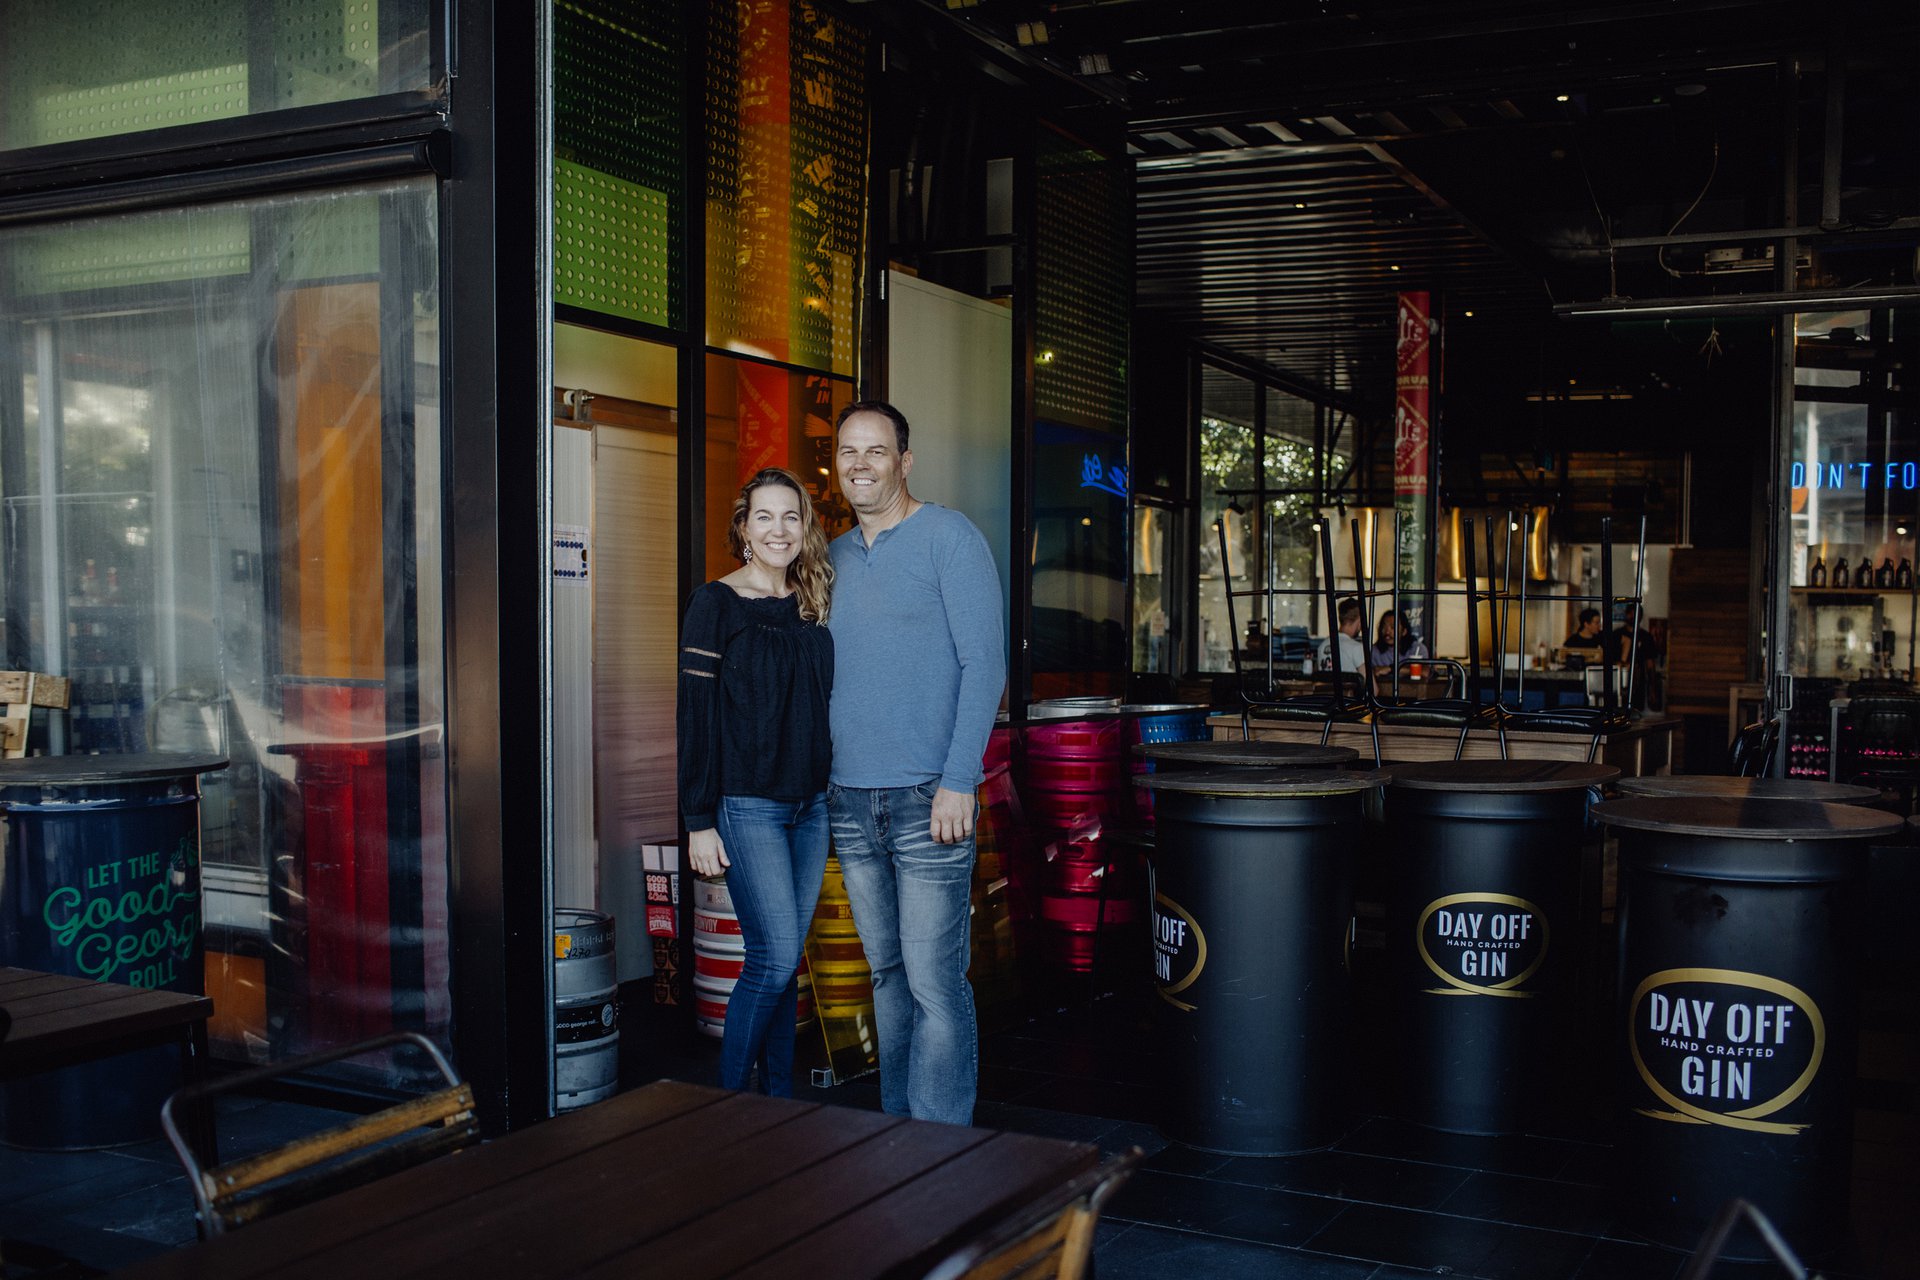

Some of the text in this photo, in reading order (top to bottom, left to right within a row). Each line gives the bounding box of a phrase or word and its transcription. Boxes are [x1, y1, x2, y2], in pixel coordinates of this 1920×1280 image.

[88, 852, 160, 889] LET THE
[646, 874, 668, 884] GOOD
[646, 882, 669, 894] BEER
[43, 867, 190, 946] Good
[1161, 916, 1187, 947] OFF
[1438, 911, 1532, 940] DAY OFF
[76, 912, 199, 983] Georg
[1446, 939, 1520, 949] HAND CRAFTED
[130, 958, 176, 990] ROLL
[1462, 950, 1507, 977] GIN
[1650, 992, 1794, 1044] DAY OFF
[1661, 1037, 1774, 1058] HAND CRAFTED
[1681, 1056, 1752, 1101] GIN
